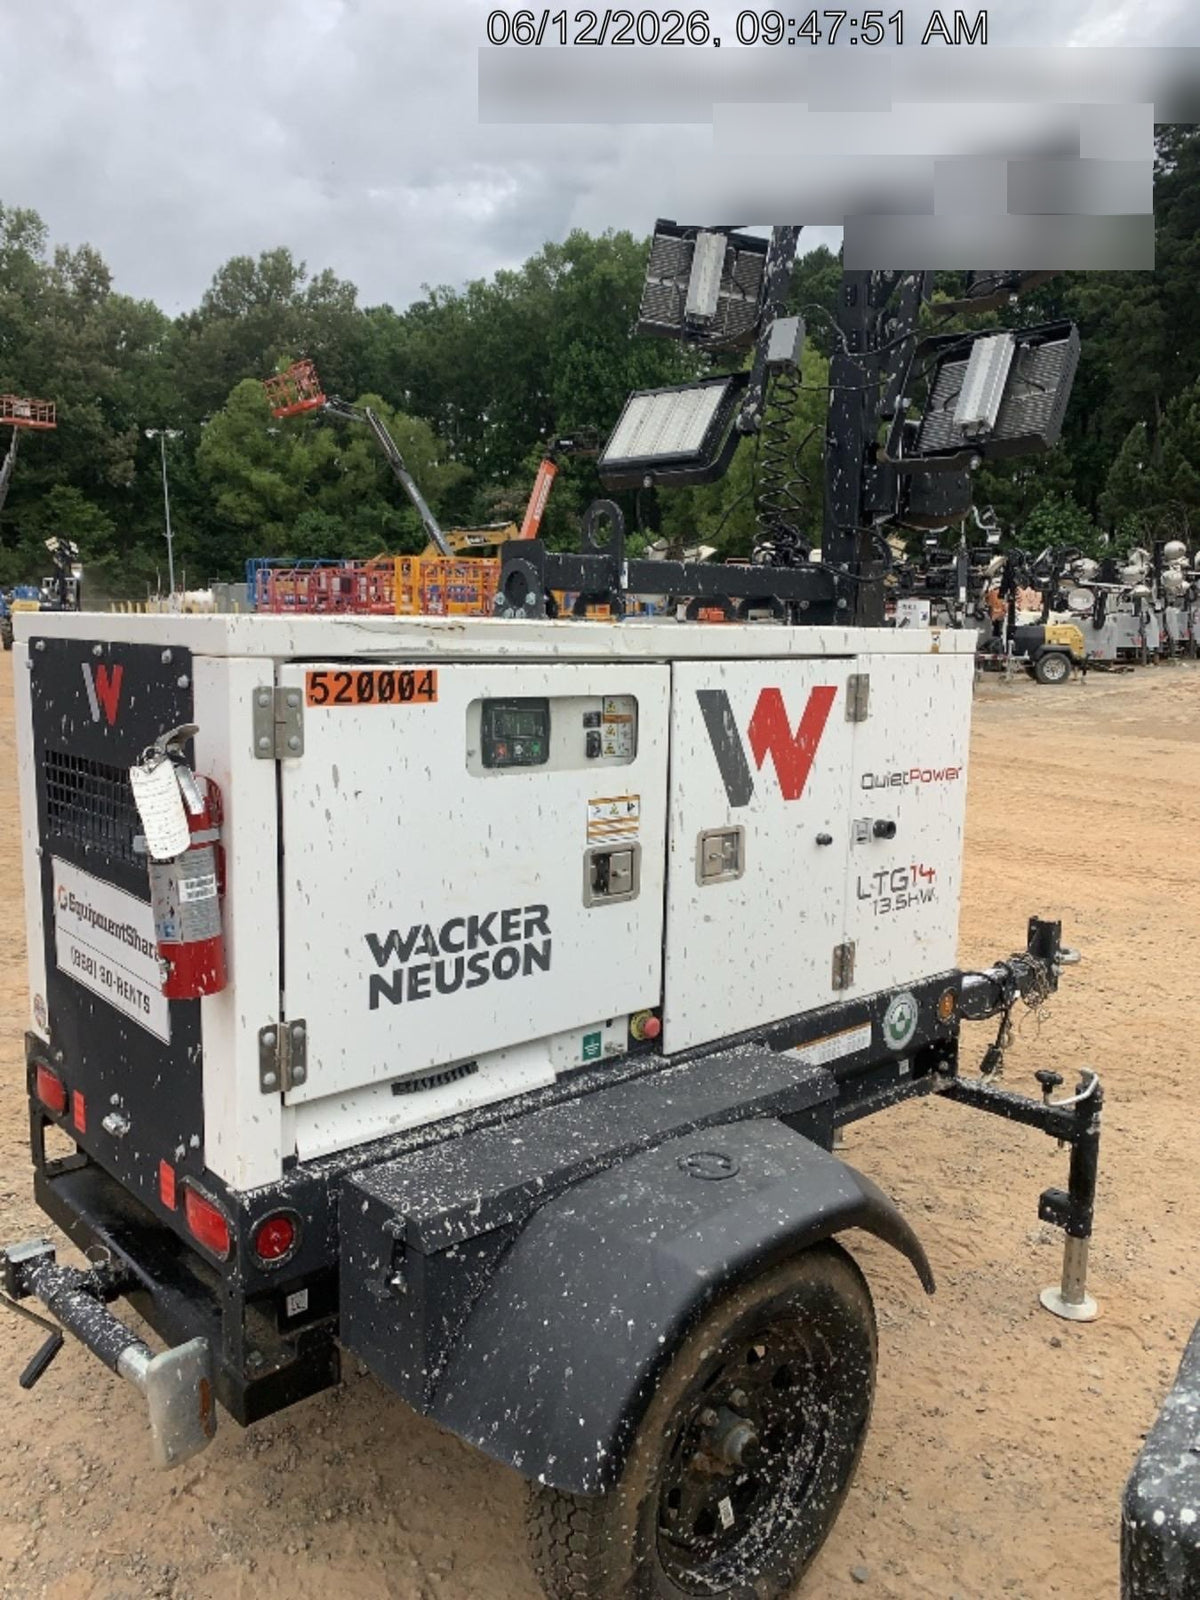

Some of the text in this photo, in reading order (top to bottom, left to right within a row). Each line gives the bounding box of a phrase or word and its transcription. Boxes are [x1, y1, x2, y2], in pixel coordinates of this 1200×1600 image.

[309, 670, 436, 704] 520004
[860, 767, 962, 790] QuietPower
[364, 904, 551, 968] WACKER
[369, 938, 552, 1010] NEUSON
